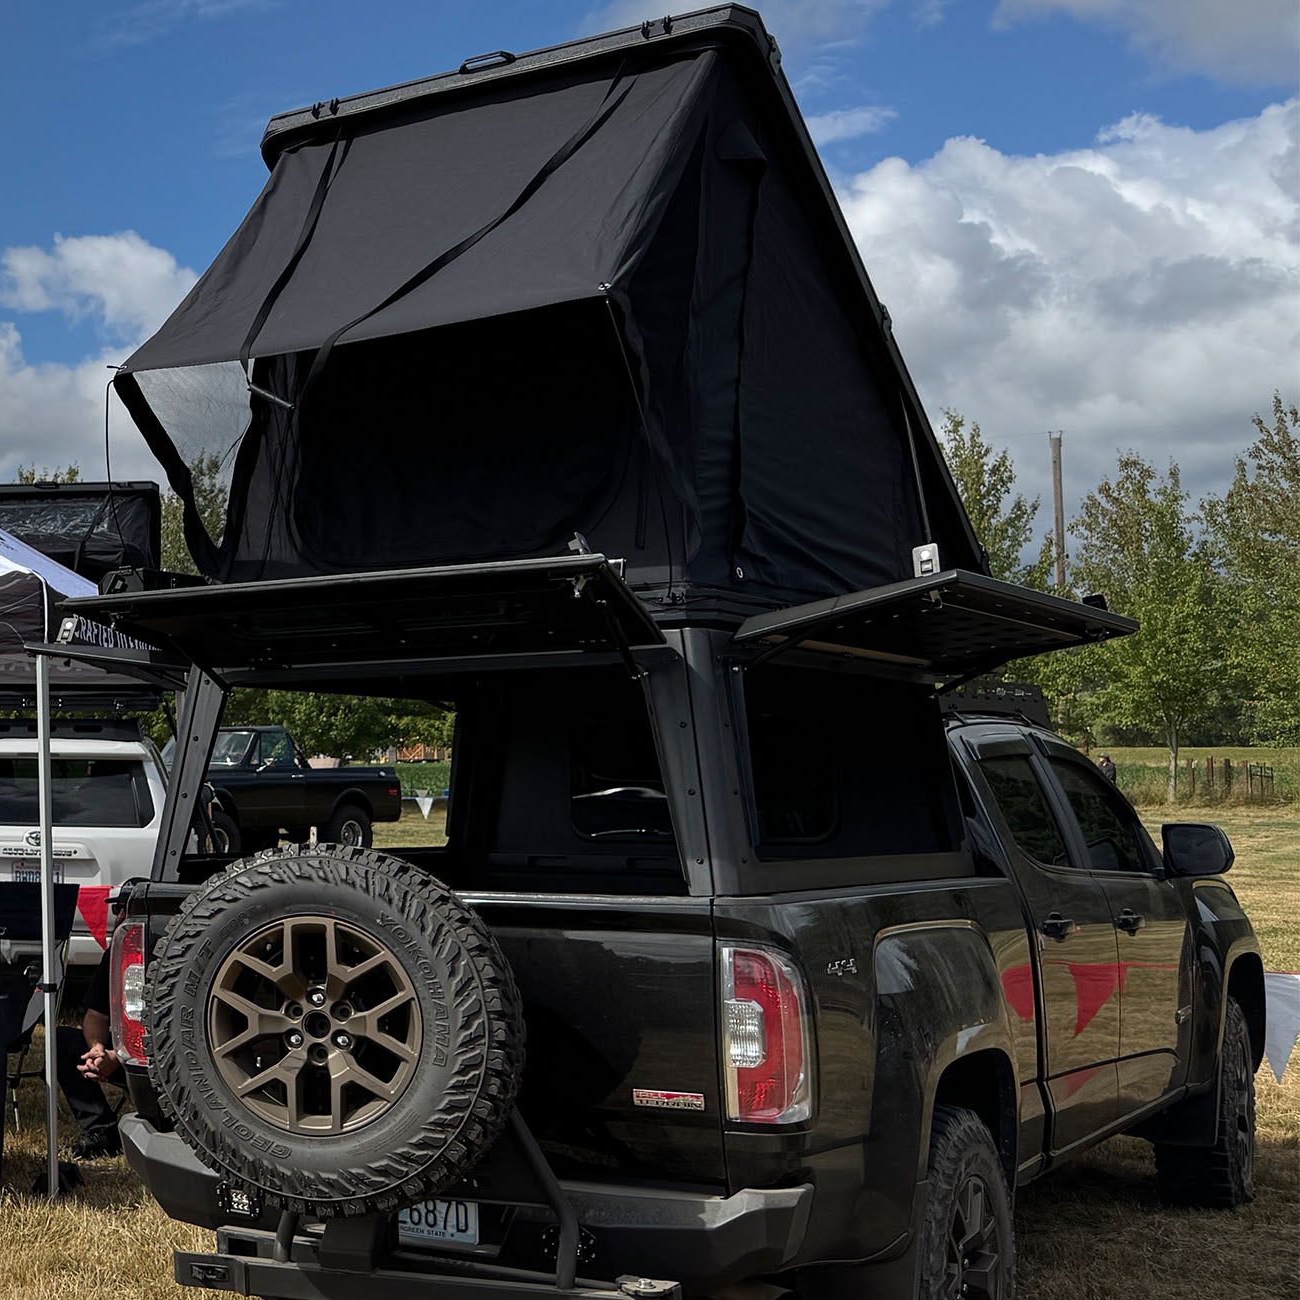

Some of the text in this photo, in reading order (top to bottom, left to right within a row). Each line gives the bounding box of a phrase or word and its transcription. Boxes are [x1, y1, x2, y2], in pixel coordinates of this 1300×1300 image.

[179, 1005, 292, 1159] GEOLANDAR
[399, 1199, 469, 1233] 687D
[426, 1229, 446, 1238] STATE
